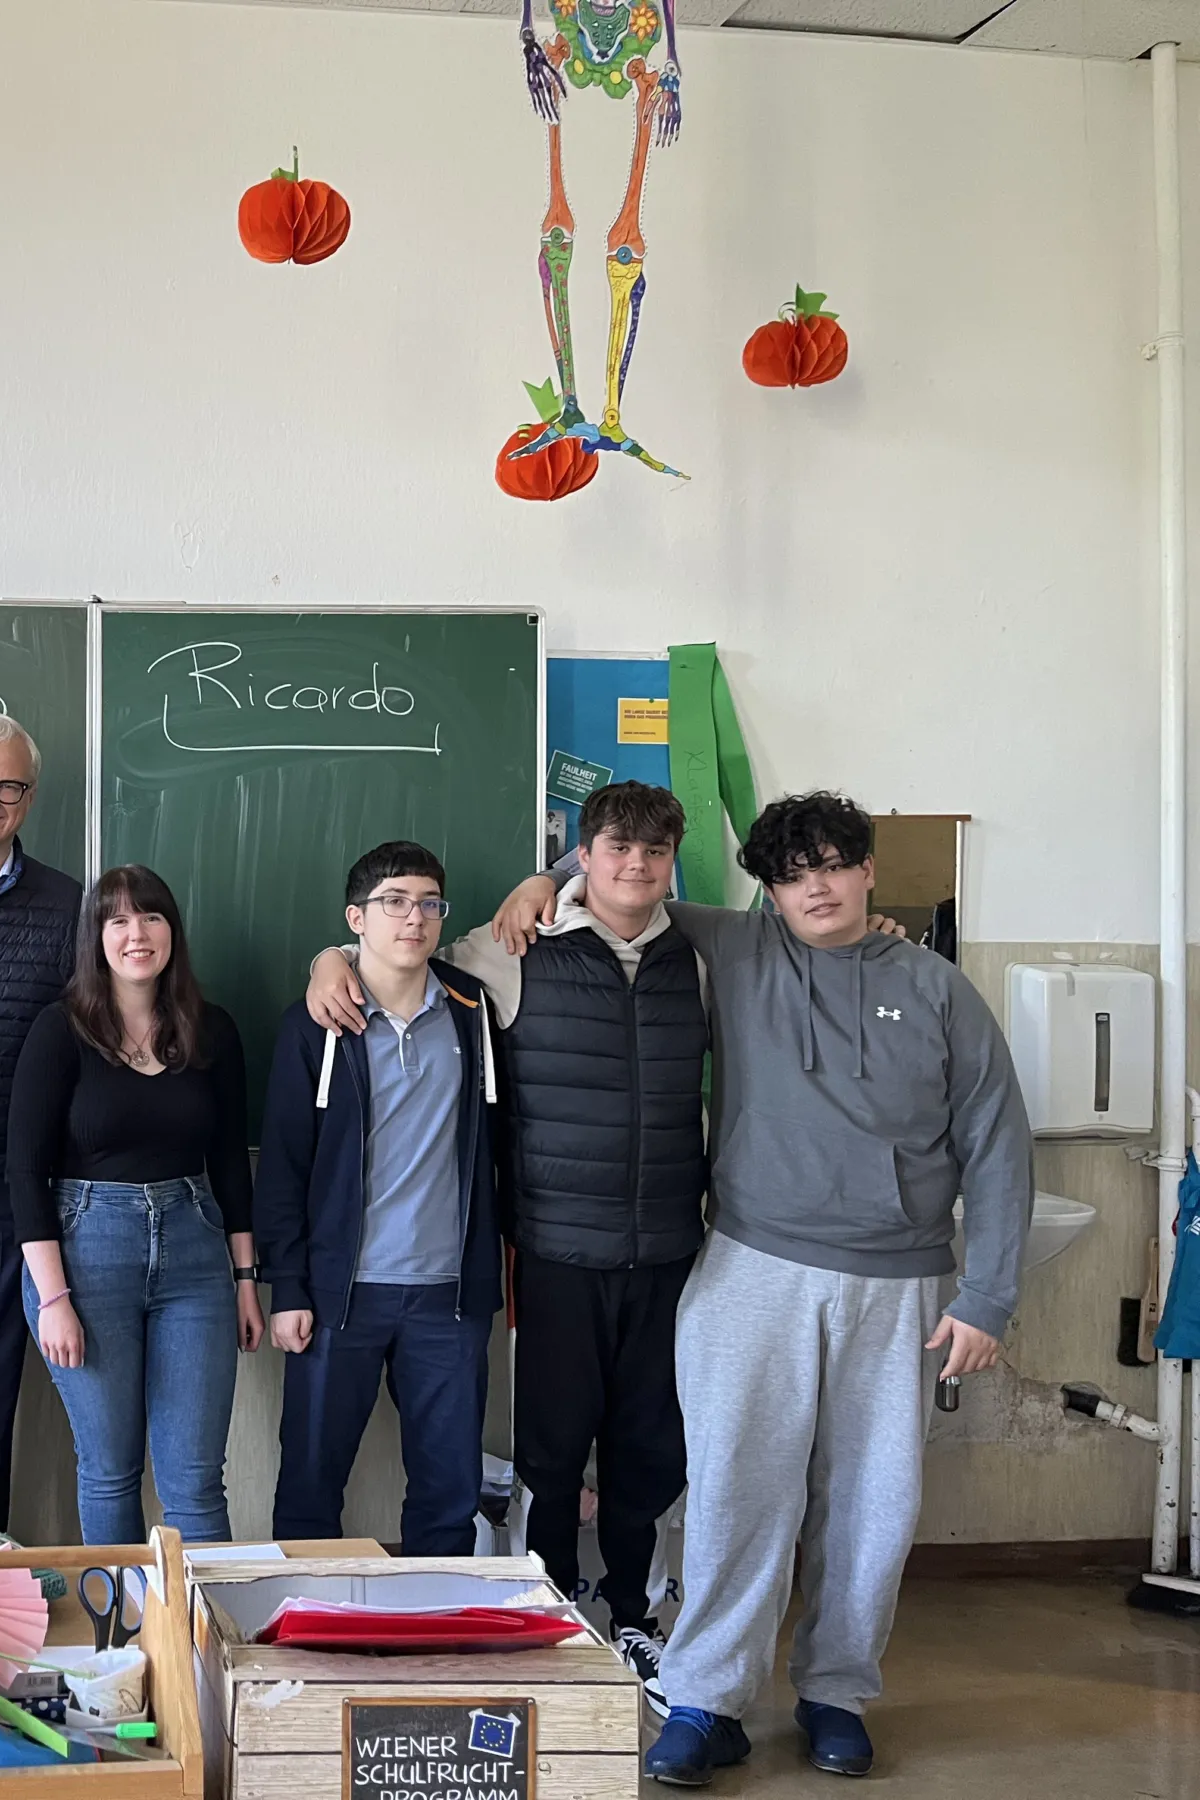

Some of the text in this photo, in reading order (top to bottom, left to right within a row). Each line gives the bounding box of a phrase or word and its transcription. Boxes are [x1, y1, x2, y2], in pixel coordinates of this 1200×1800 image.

[147, 641, 415, 716] Ricardo
[560, 762, 598, 782] FAULHEIT
[355, 1736, 458, 1758] WIENER
[354, 1761, 525, 1786] SCHULFRUCHT-
